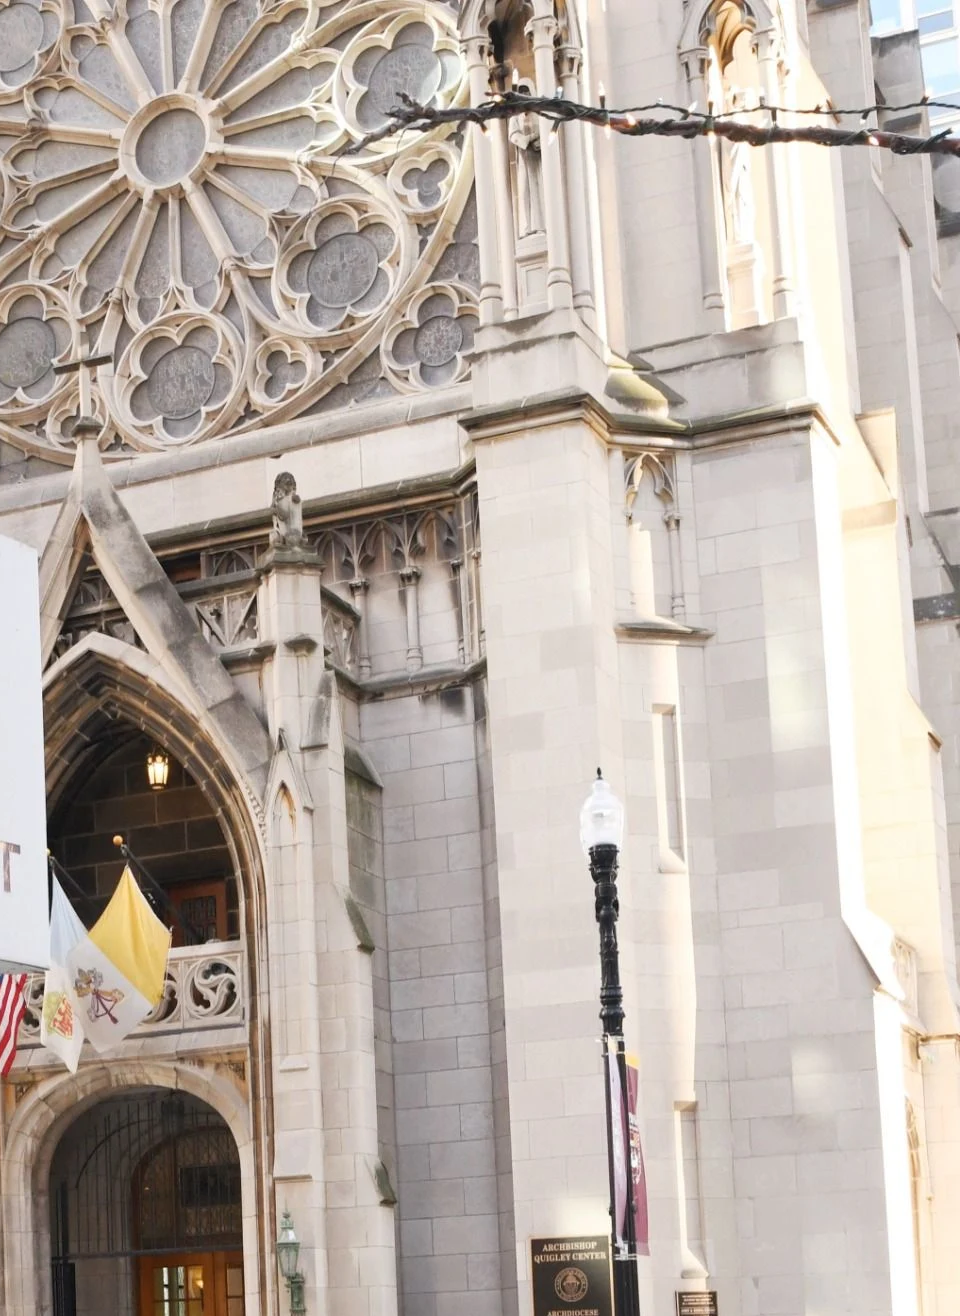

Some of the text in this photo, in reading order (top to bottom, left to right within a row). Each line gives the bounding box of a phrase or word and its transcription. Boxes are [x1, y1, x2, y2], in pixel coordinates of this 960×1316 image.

[542, 1241, 598, 1252] ARCHBISHOP
[533, 1251, 607, 1264] QUIGLEY CENTER
